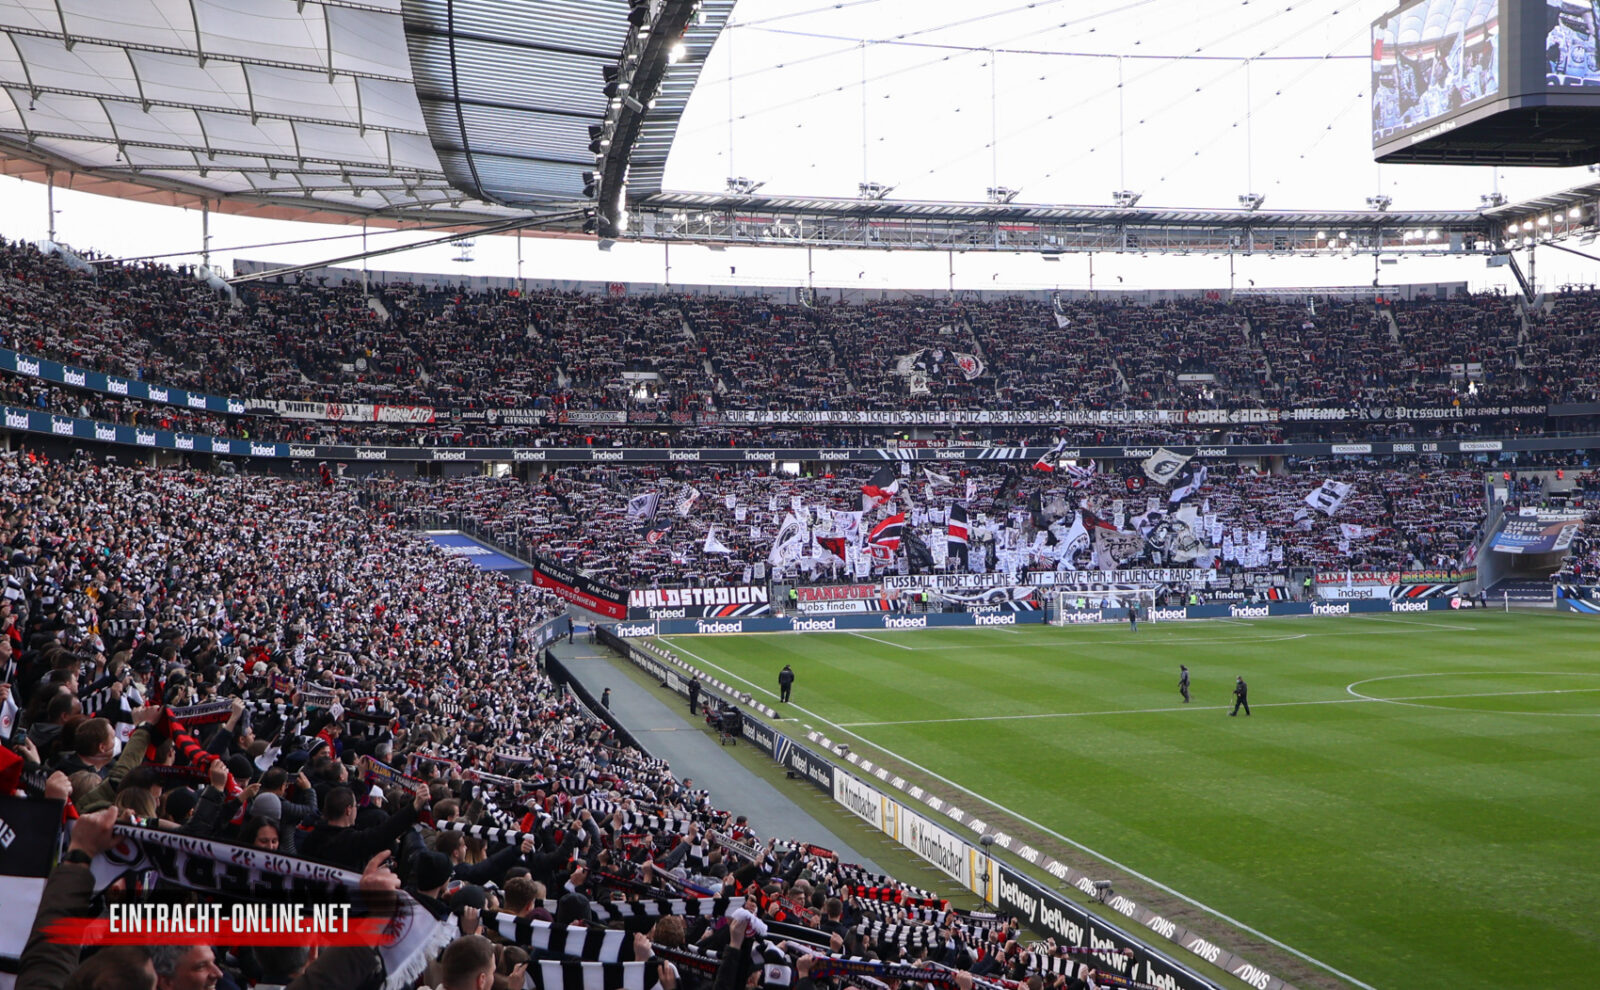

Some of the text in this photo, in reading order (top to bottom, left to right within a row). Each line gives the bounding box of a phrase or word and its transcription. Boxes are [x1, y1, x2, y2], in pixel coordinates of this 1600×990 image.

[16, 353, 39, 376] indeed
[63, 366, 85, 386] indeed
[107, 375, 128, 394] indeed
[148, 384, 168, 402] indeed
[187, 392, 206, 408] indeed
[227, 399, 244, 414] inde
[284, 402, 315, 413] WHITE
[497, 408, 546, 417] COMMANDO
[1294, 408, 1346, 420] INFERNO
[1395, 405, 1464, 419] Presswerk
[1511, 405, 1546, 414] FRANKFURT
[5, 407, 29, 429] indeed
[503, 416, 540, 424] GIESSEN
[727, 412, 749, 421] EURE
[753, 412, 769, 421] APP
[773, 411, 783, 420] IST
[787, 411, 823, 421] SCHROTT
[827, 412, 843, 421] UND
[846, 412, 862, 420] DAS
[867, 411, 940, 421] TICKETING-SYSTEM
[944, 411, 956, 420] EIN
[959, 412, 980, 420] WITZ
[988, 411, 1004, 420] DAS
[1008, 411, 1027, 420] MUSS
[1029, 411, 1056, 420] DIESES
[52, 415, 73, 435] indeed
[95, 421, 116, 441] indeed
[136, 428, 156, 446] indeed
[175, 432, 194, 449] indeed
[212, 437, 230, 453] indeed
[250, 442, 275, 456] indeed
[289, 445, 315, 457] indeed
[1196, 447, 1227, 456] indeed
[1392, 443, 1438, 452] BEMBEL CLUB
[355, 448, 386, 459] indeed
[431, 450, 465, 460] indeed
[512, 450, 545, 460] indeed
[590, 450, 623, 460] indeed
[667, 450, 699, 460] indeed
[744, 450, 775, 460] indeed
[818, 450, 849, 460] indeed
[935, 449, 965, 458] indeed
[1122, 448, 1153, 457] indeed
[540, 562, 620, 601] EINTRACHT FAN-CLUB
[885, 576, 932, 588] FUSSBALL
[936, 575, 968, 587] FINDET
[973, 574, 1010, 586] OFFLINE
[1015, 572, 1045, 585] SATT
[1054, 571, 1082, 583] KURVE
[1087, 570, 1105, 582] REIN
[1111, 568, 1164, 581] INFLUENCER
[556, 586, 598, 608] SOSSENHEIM
[630, 586, 769, 607] WALDSTADION
[1215, 590, 1246, 600] finden
[1338, 588, 1373, 598] indeed
[806, 600, 857, 613] obs finden
[1228, 604, 1269, 617] indeed
[1310, 601, 1349, 614] indeed
[1389, 598, 1429, 611] indeed
[647, 607, 686, 618] indeed
[971, 612, 1015, 625] indeed
[1062, 609, 1102, 621] indeed
[1148, 606, 1187, 618] indeed
[695, 620, 743, 633] indeed
[790, 616, 836, 629] indeed
[882, 614, 927, 627] indeed
[616, 624, 655, 637] indeed
[741, 716, 756, 741] indeed
[791, 746, 808, 775] indeed
[817, 769, 830, 788] finden
[845, 777, 878, 822] Krombacher
[929, 797, 943, 810] DWS
[949, 807, 965, 822] DWS
[971, 819, 987, 834] DWS
[994, 833, 1011, 848] DWS
[918, 821, 963, 879] Krombacher
[1020, 846, 1038, 863] DWS
[1049, 861, 1068, 879] DWS
[1078, 877, 1098, 896] DWS
[1000, 873, 1083, 947] betway betway
[1112, 896, 1136, 917] DWS
[1150, 916, 1176, 939] DWS
[1192, 939, 1221, 963] DWS
[1239, 964, 1270, 990] DWS
